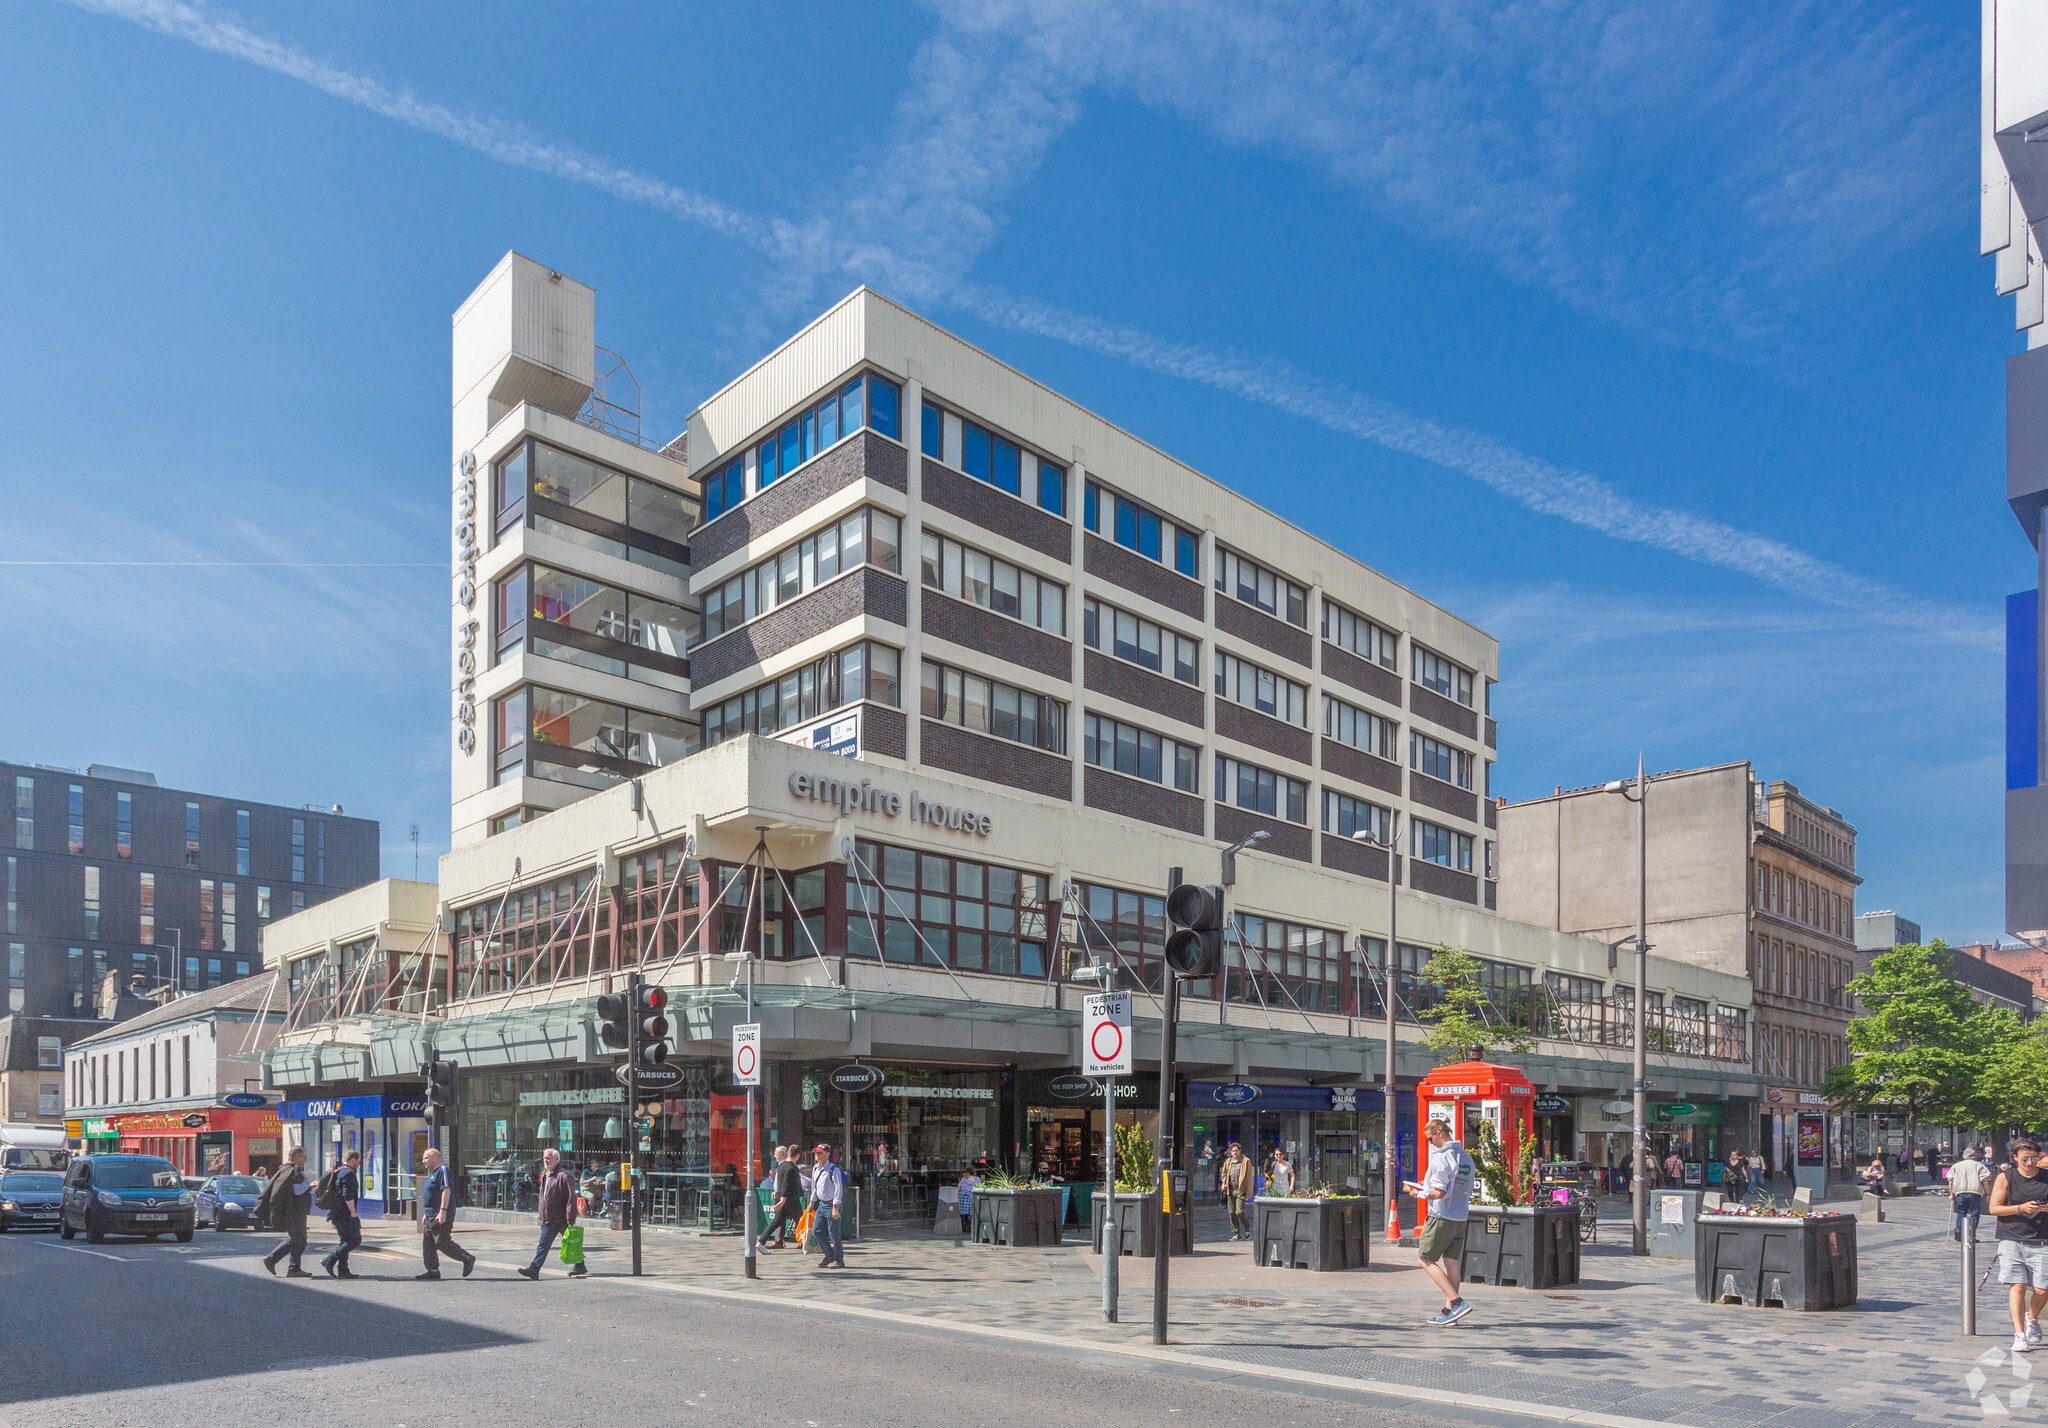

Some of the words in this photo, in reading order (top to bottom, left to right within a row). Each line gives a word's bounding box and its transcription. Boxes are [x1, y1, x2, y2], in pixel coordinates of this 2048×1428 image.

[457, 450, 477, 605] empire
[458, 618, 479, 757] house
[789, 771, 903, 816] empire
[911, 789, 994, 836] house
[1086, 994, 1128, 1004] PEDESTRIAN
[1092, 1004, 1121, 1016] ZONE
[738, 1033, 755, 1041] ZONE
[636, 1071, 677, 1079] TARBUCKS
[519, 1089, 580, 1106] STARBUCKS
[580, 1087, 625, 1104] COFFEE
[883, 1086, 952, 1098] STARBUCKS
[952, 1088, 994, 1099] COFFEE
[307, 1101, 337, 1116] CORAL
[390, 1102, 429, 1111] CORA
